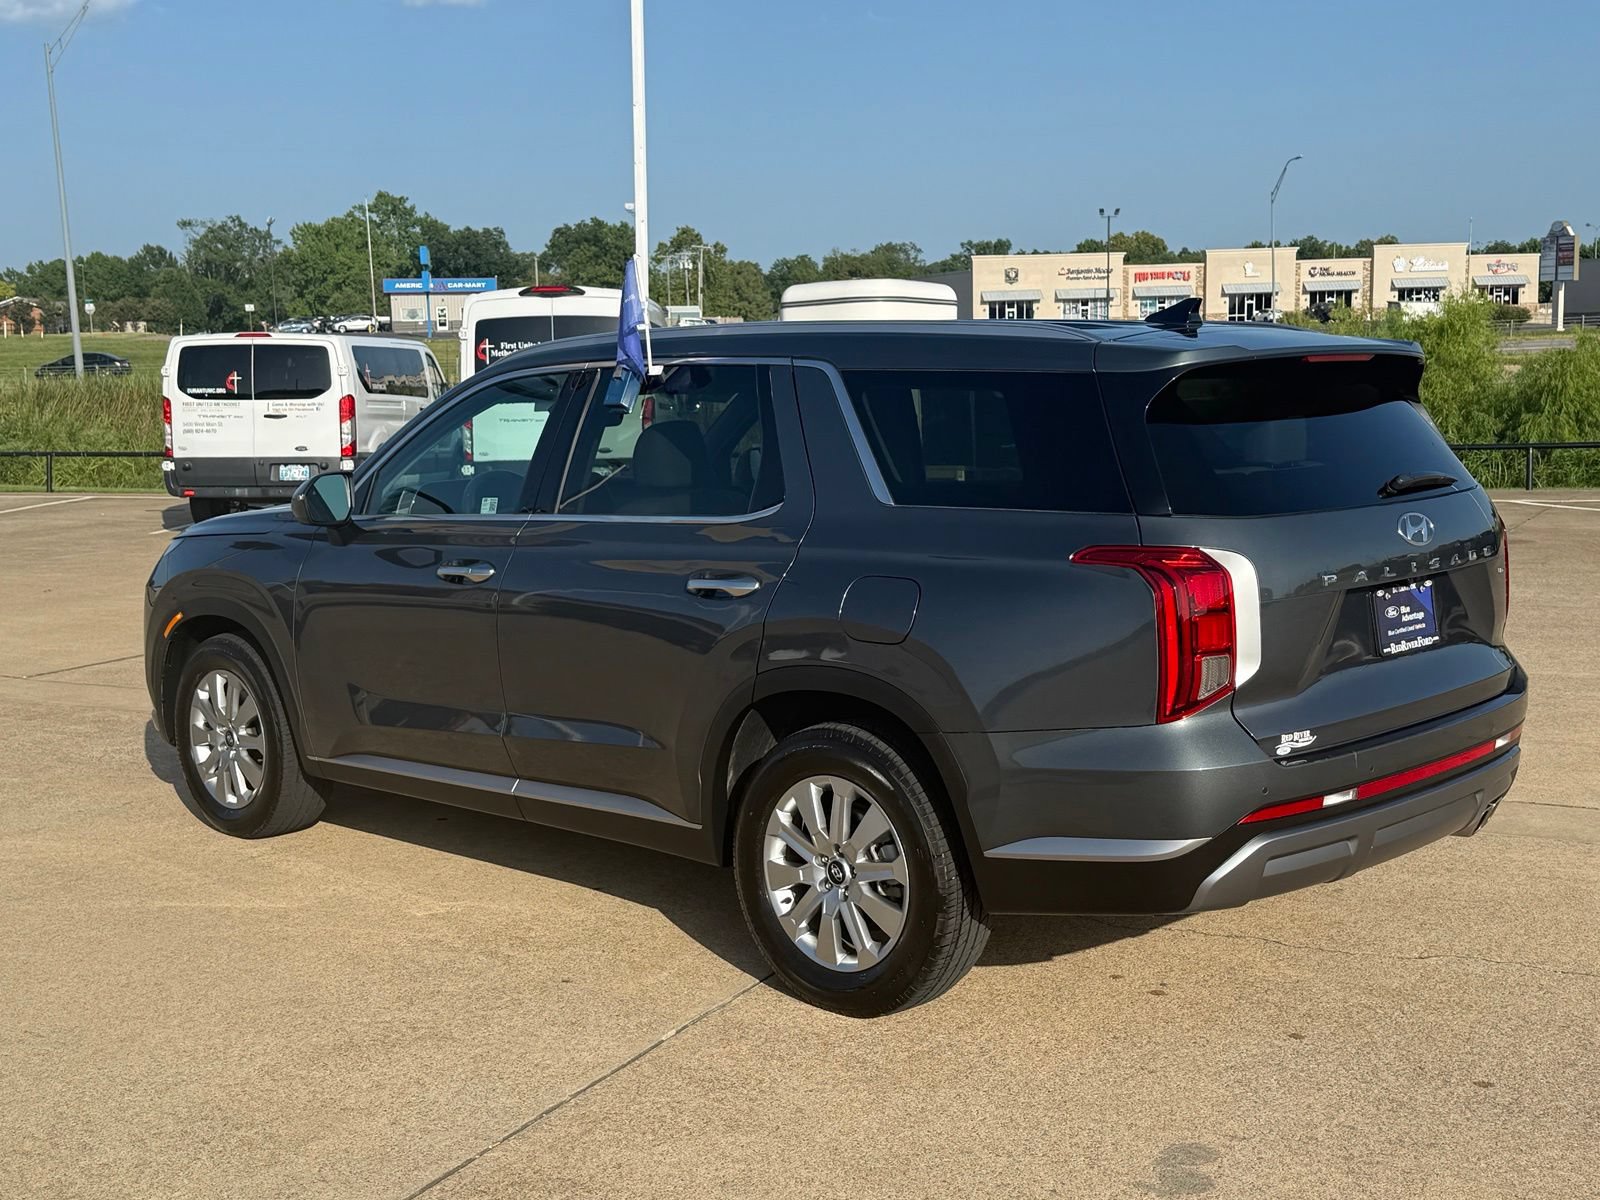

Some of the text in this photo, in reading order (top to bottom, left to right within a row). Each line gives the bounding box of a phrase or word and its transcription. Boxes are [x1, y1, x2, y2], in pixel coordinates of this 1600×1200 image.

[500, 341, 541, 350] First Unit
[1322, 544, 1494, 587] PALISADE
